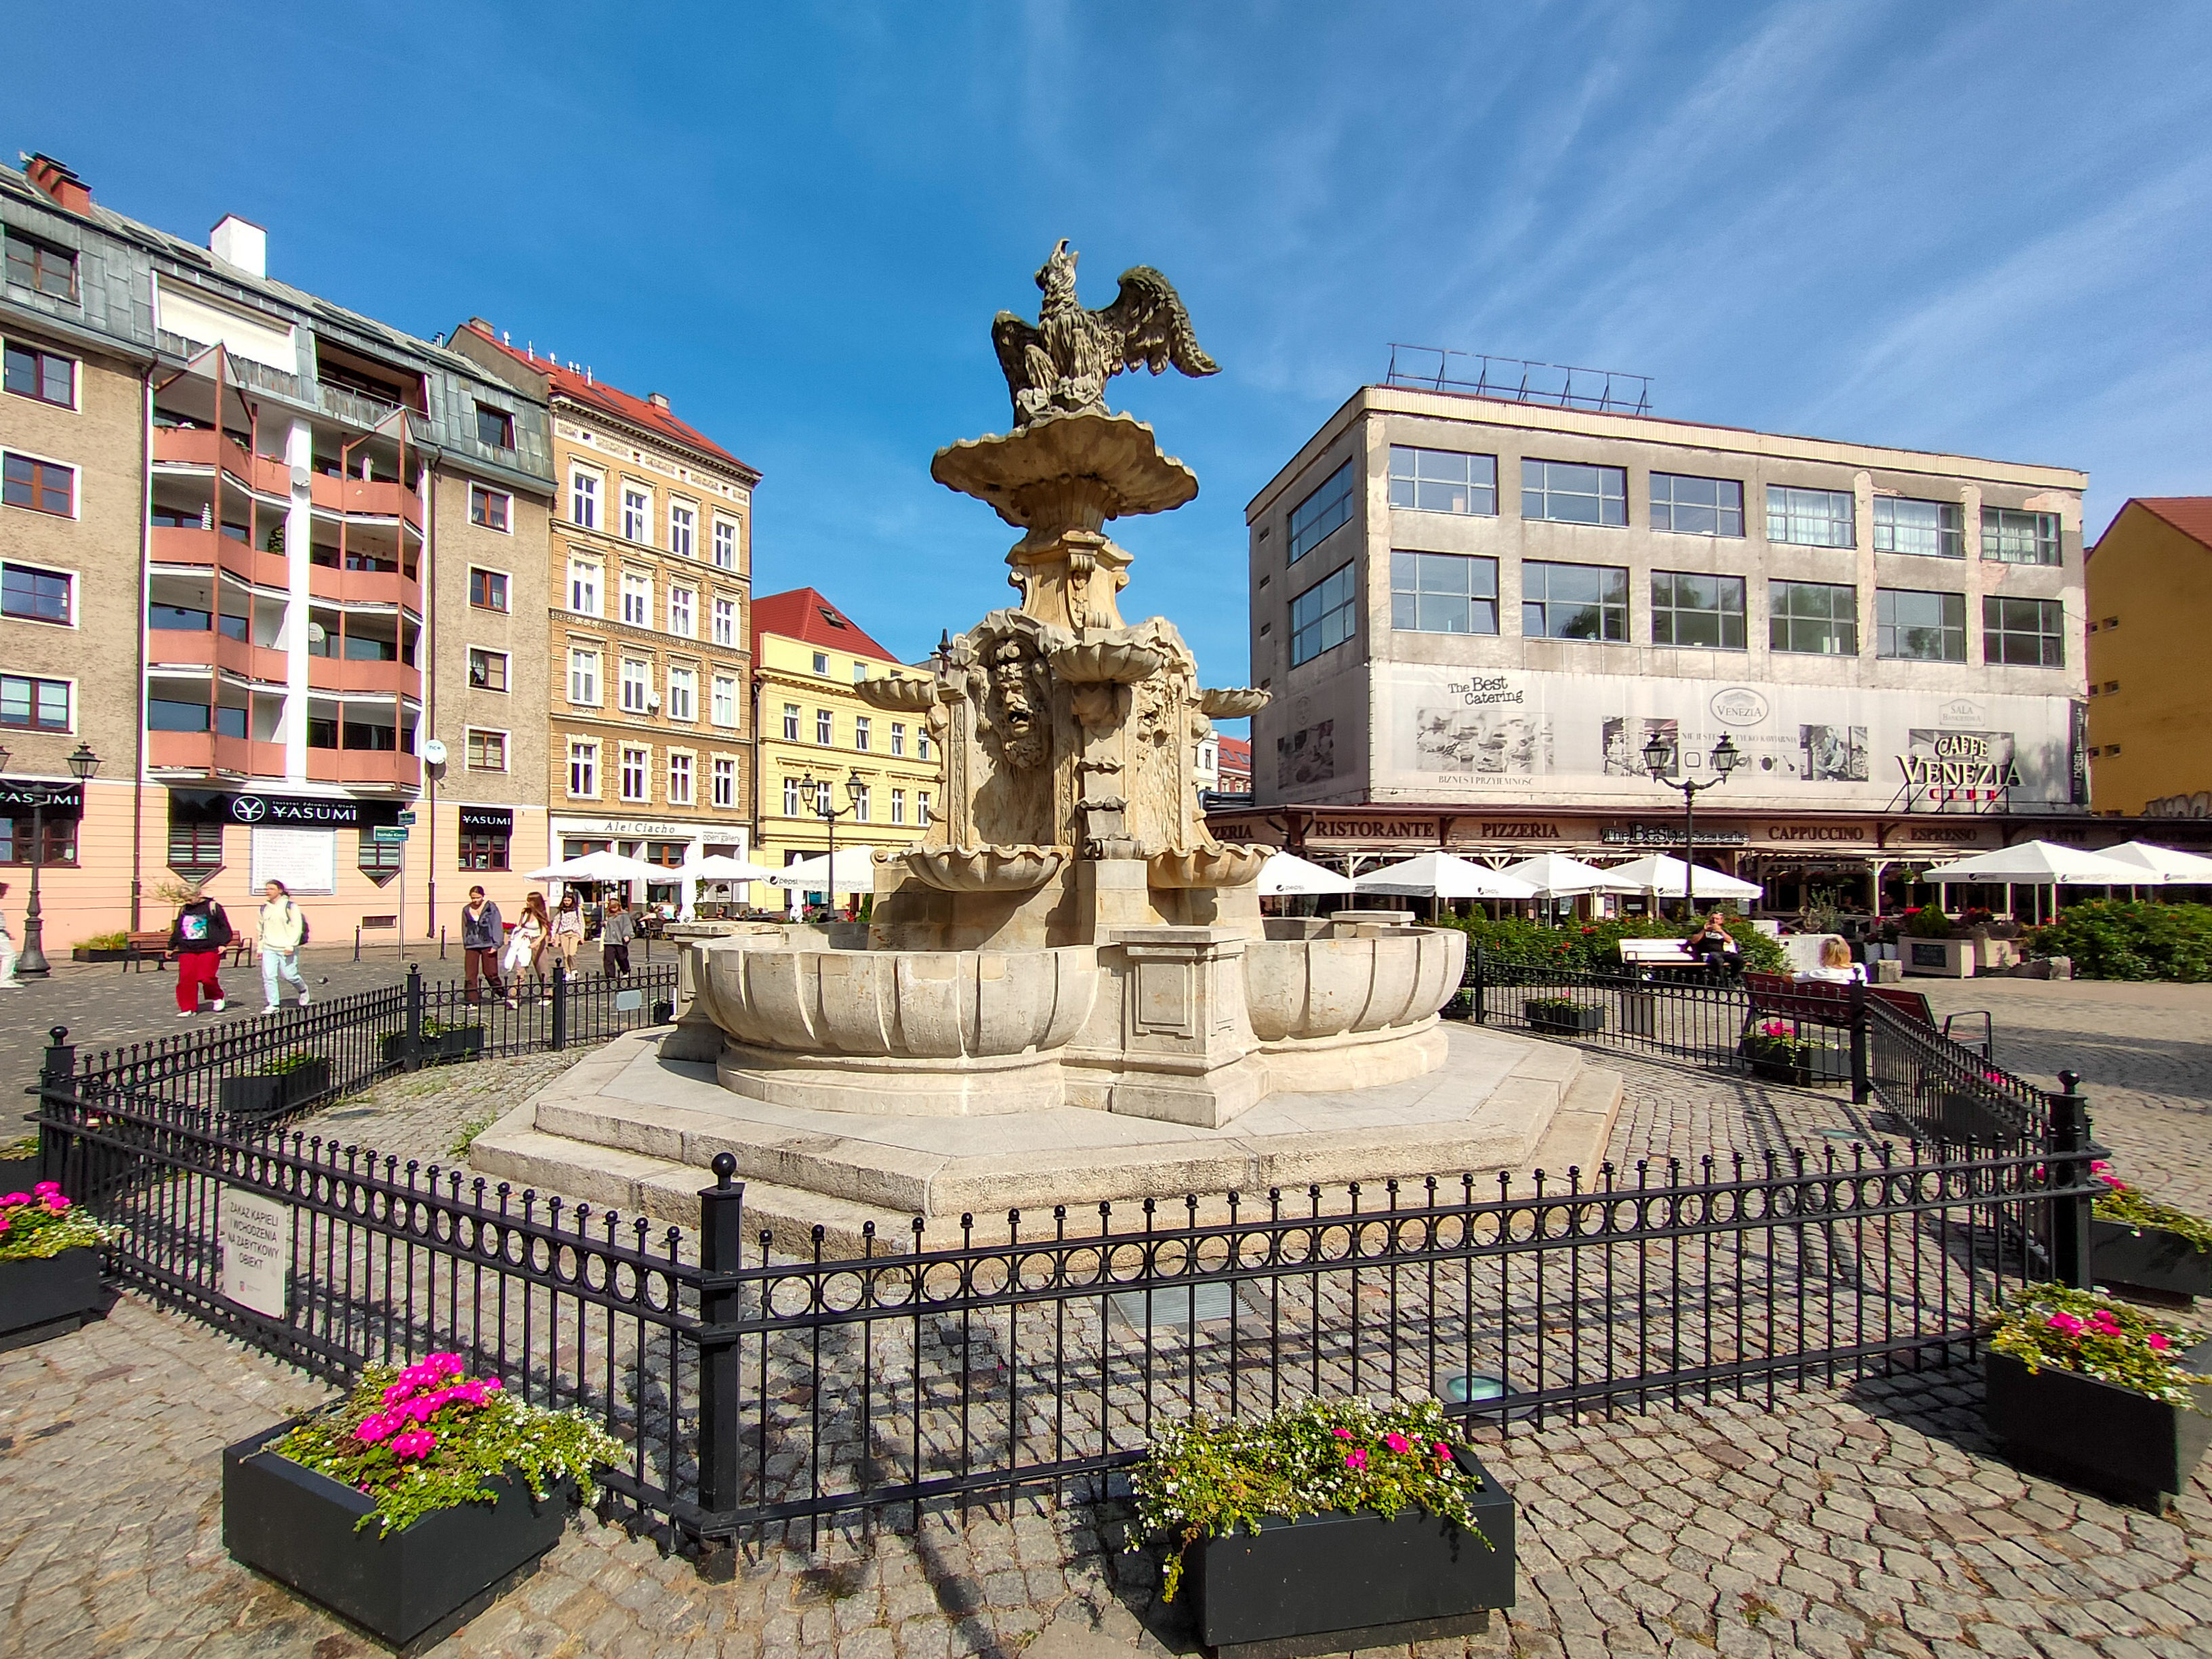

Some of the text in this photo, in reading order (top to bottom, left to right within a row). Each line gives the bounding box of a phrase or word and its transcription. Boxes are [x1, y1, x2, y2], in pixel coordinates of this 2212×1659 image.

[1448, 675, 1509, 694] The Best
[1465, 690, 1524, 706] Catering
[1717, 705, 1763, 718] VENEZIA
[1950, 704, 1974, 716] SALA
[1935, 735, 1988, 757] CAFFE
[1895, 754, 2026, 787] VENEZIA
[1438, 775, 1469, 783] BIZNES
[272, 806, 357, 821] YASUMI
[462, 815, 511, 825] YASUMI
[604, 821, 676, 834] Ale! Ciacho
[1314, 821, 1435, 838] RISTORANTE
[1481, 821, 1561, 838] PIZZERIA
[1602, 827, 1630, 842] The
[1629, 822, 1677, 842] Best
[1767, 826, 1864, 841] CAPPUCCINO
[1910, 828, 1978, 842] ESPRESSO
[720, 834, 741, 844] gallery
[230, 1202, 251, 1218] ZAKAZ
[233, 1220, 278, 1243] WCHODZENIA
[228, 1231, 280, 1259] NA ZABYTKOWY
